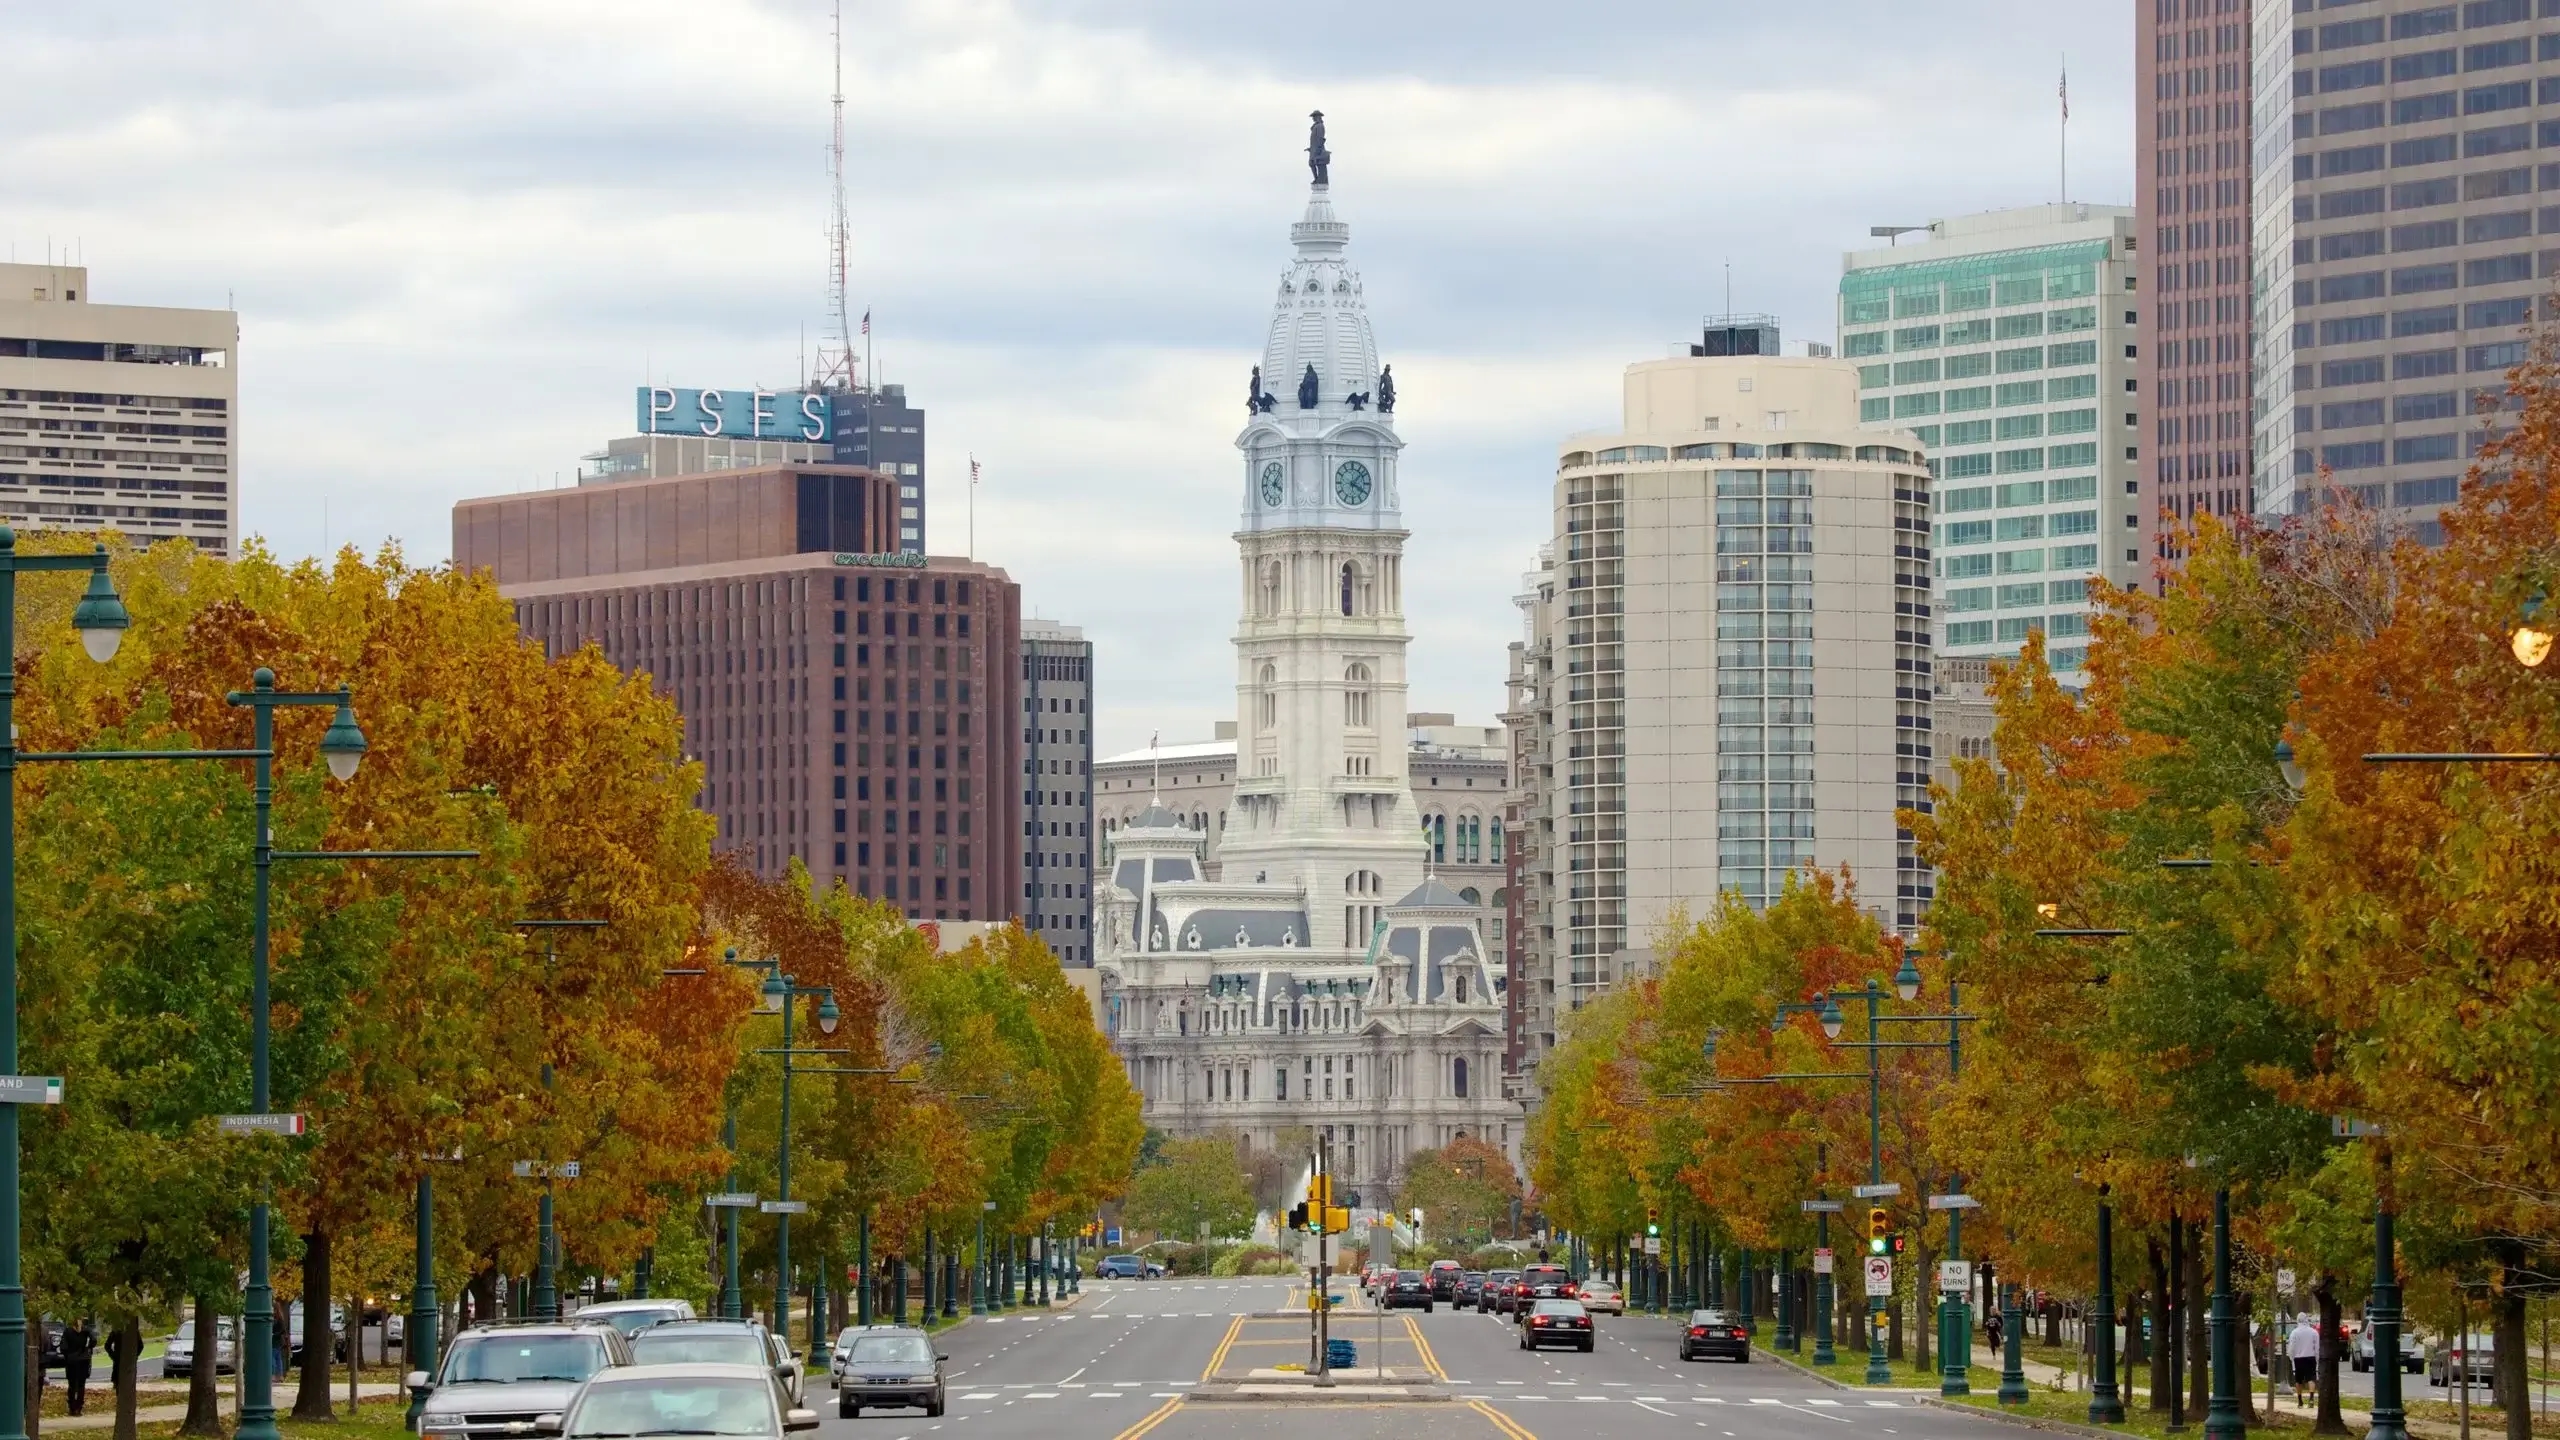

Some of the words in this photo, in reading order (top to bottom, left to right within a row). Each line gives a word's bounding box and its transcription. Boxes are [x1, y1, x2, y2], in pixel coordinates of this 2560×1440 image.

[650, 387, 825, 440] PSFS
[226, 1116, 280, 1125] INDONESIA
[1949, 1266, 1962, 1274] NO
[2280, 1272, 2290, 1280] NO
[1943, 1278, 1968, 1286] TURNS
